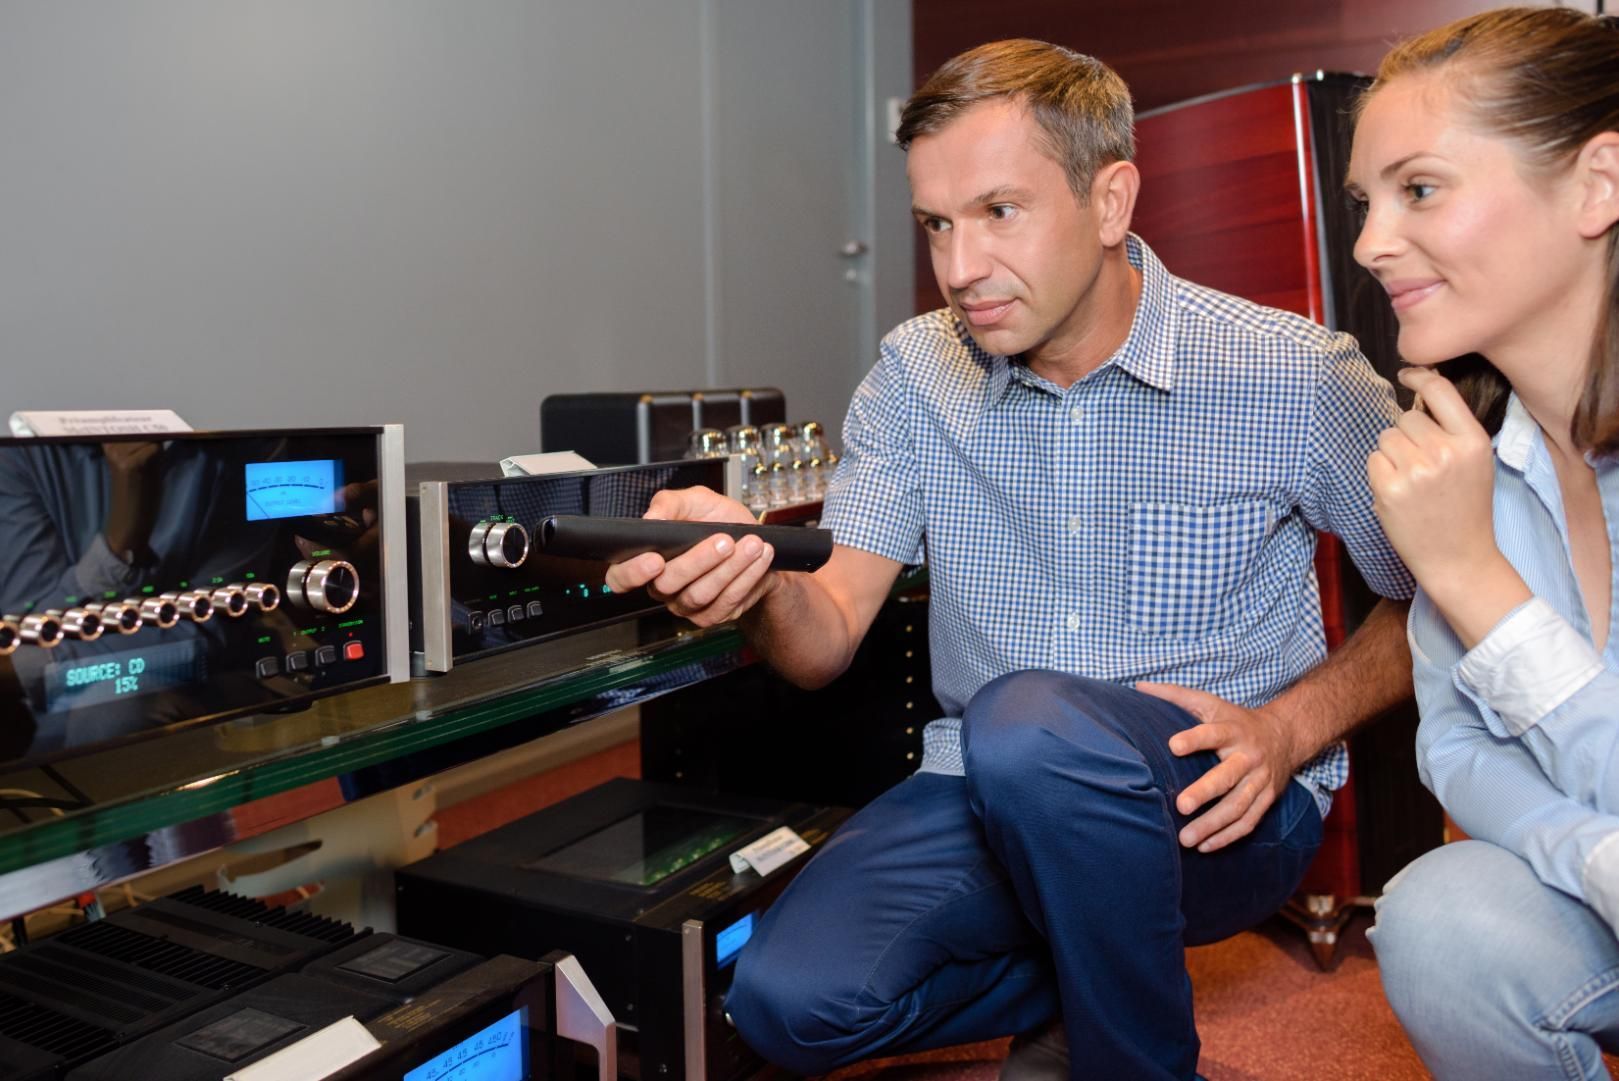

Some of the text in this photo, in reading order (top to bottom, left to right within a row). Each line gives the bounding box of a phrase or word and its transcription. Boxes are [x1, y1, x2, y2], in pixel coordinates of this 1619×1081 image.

[66, 657, 145, 687] SOURCE: CD
[115, 675, 138, 694] 15%
